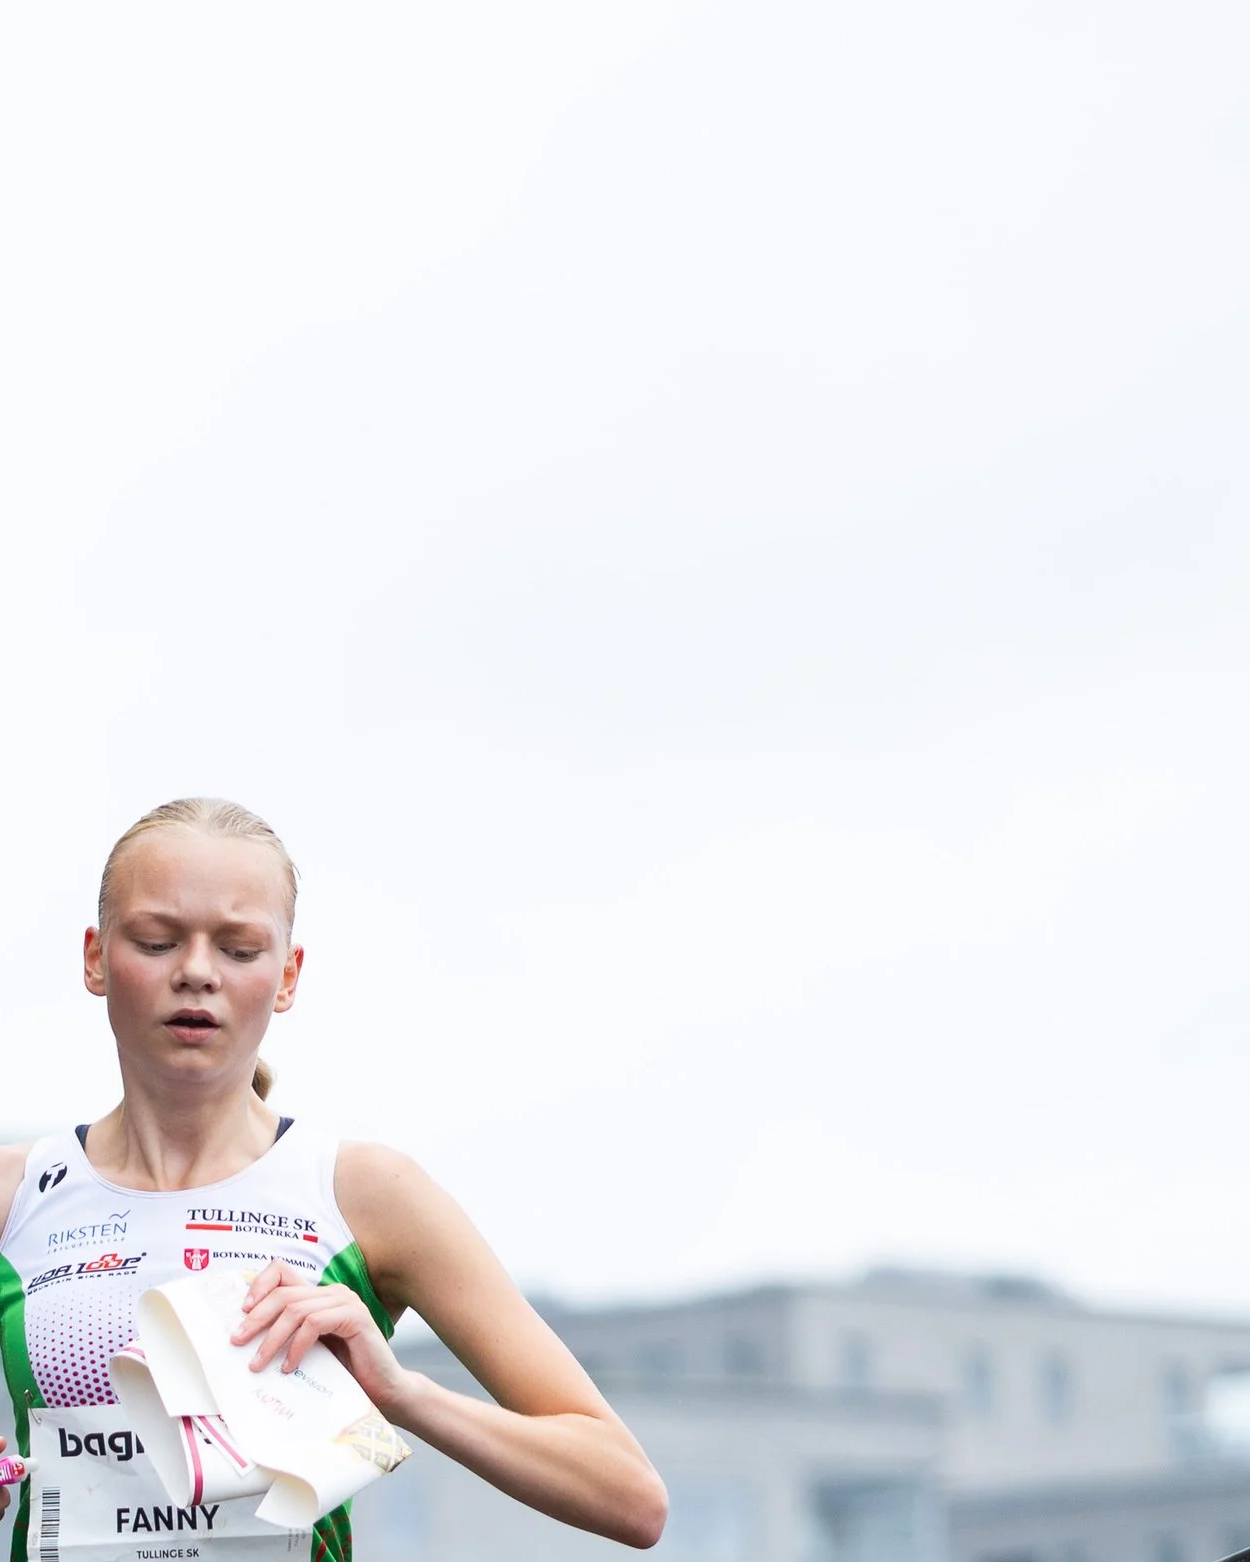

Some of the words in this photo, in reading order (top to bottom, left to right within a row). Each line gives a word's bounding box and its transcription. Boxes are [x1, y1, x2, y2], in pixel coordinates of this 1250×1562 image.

[187, 1208, 289, 1228] TULLINGE
[293, 1218, 318, 1233] SK
[48, 1222, 126, 1247] RIKSTEN
[235, 1225, 299, 1240] BOTKYRKA
[212, 1251, 268, 1261] BOTKYRKA
[116, 1505, 220, 1533] FANNY
[136, 1549, 183, 1560] TULLINGE
[186, 1548, 200, 1558] SK
